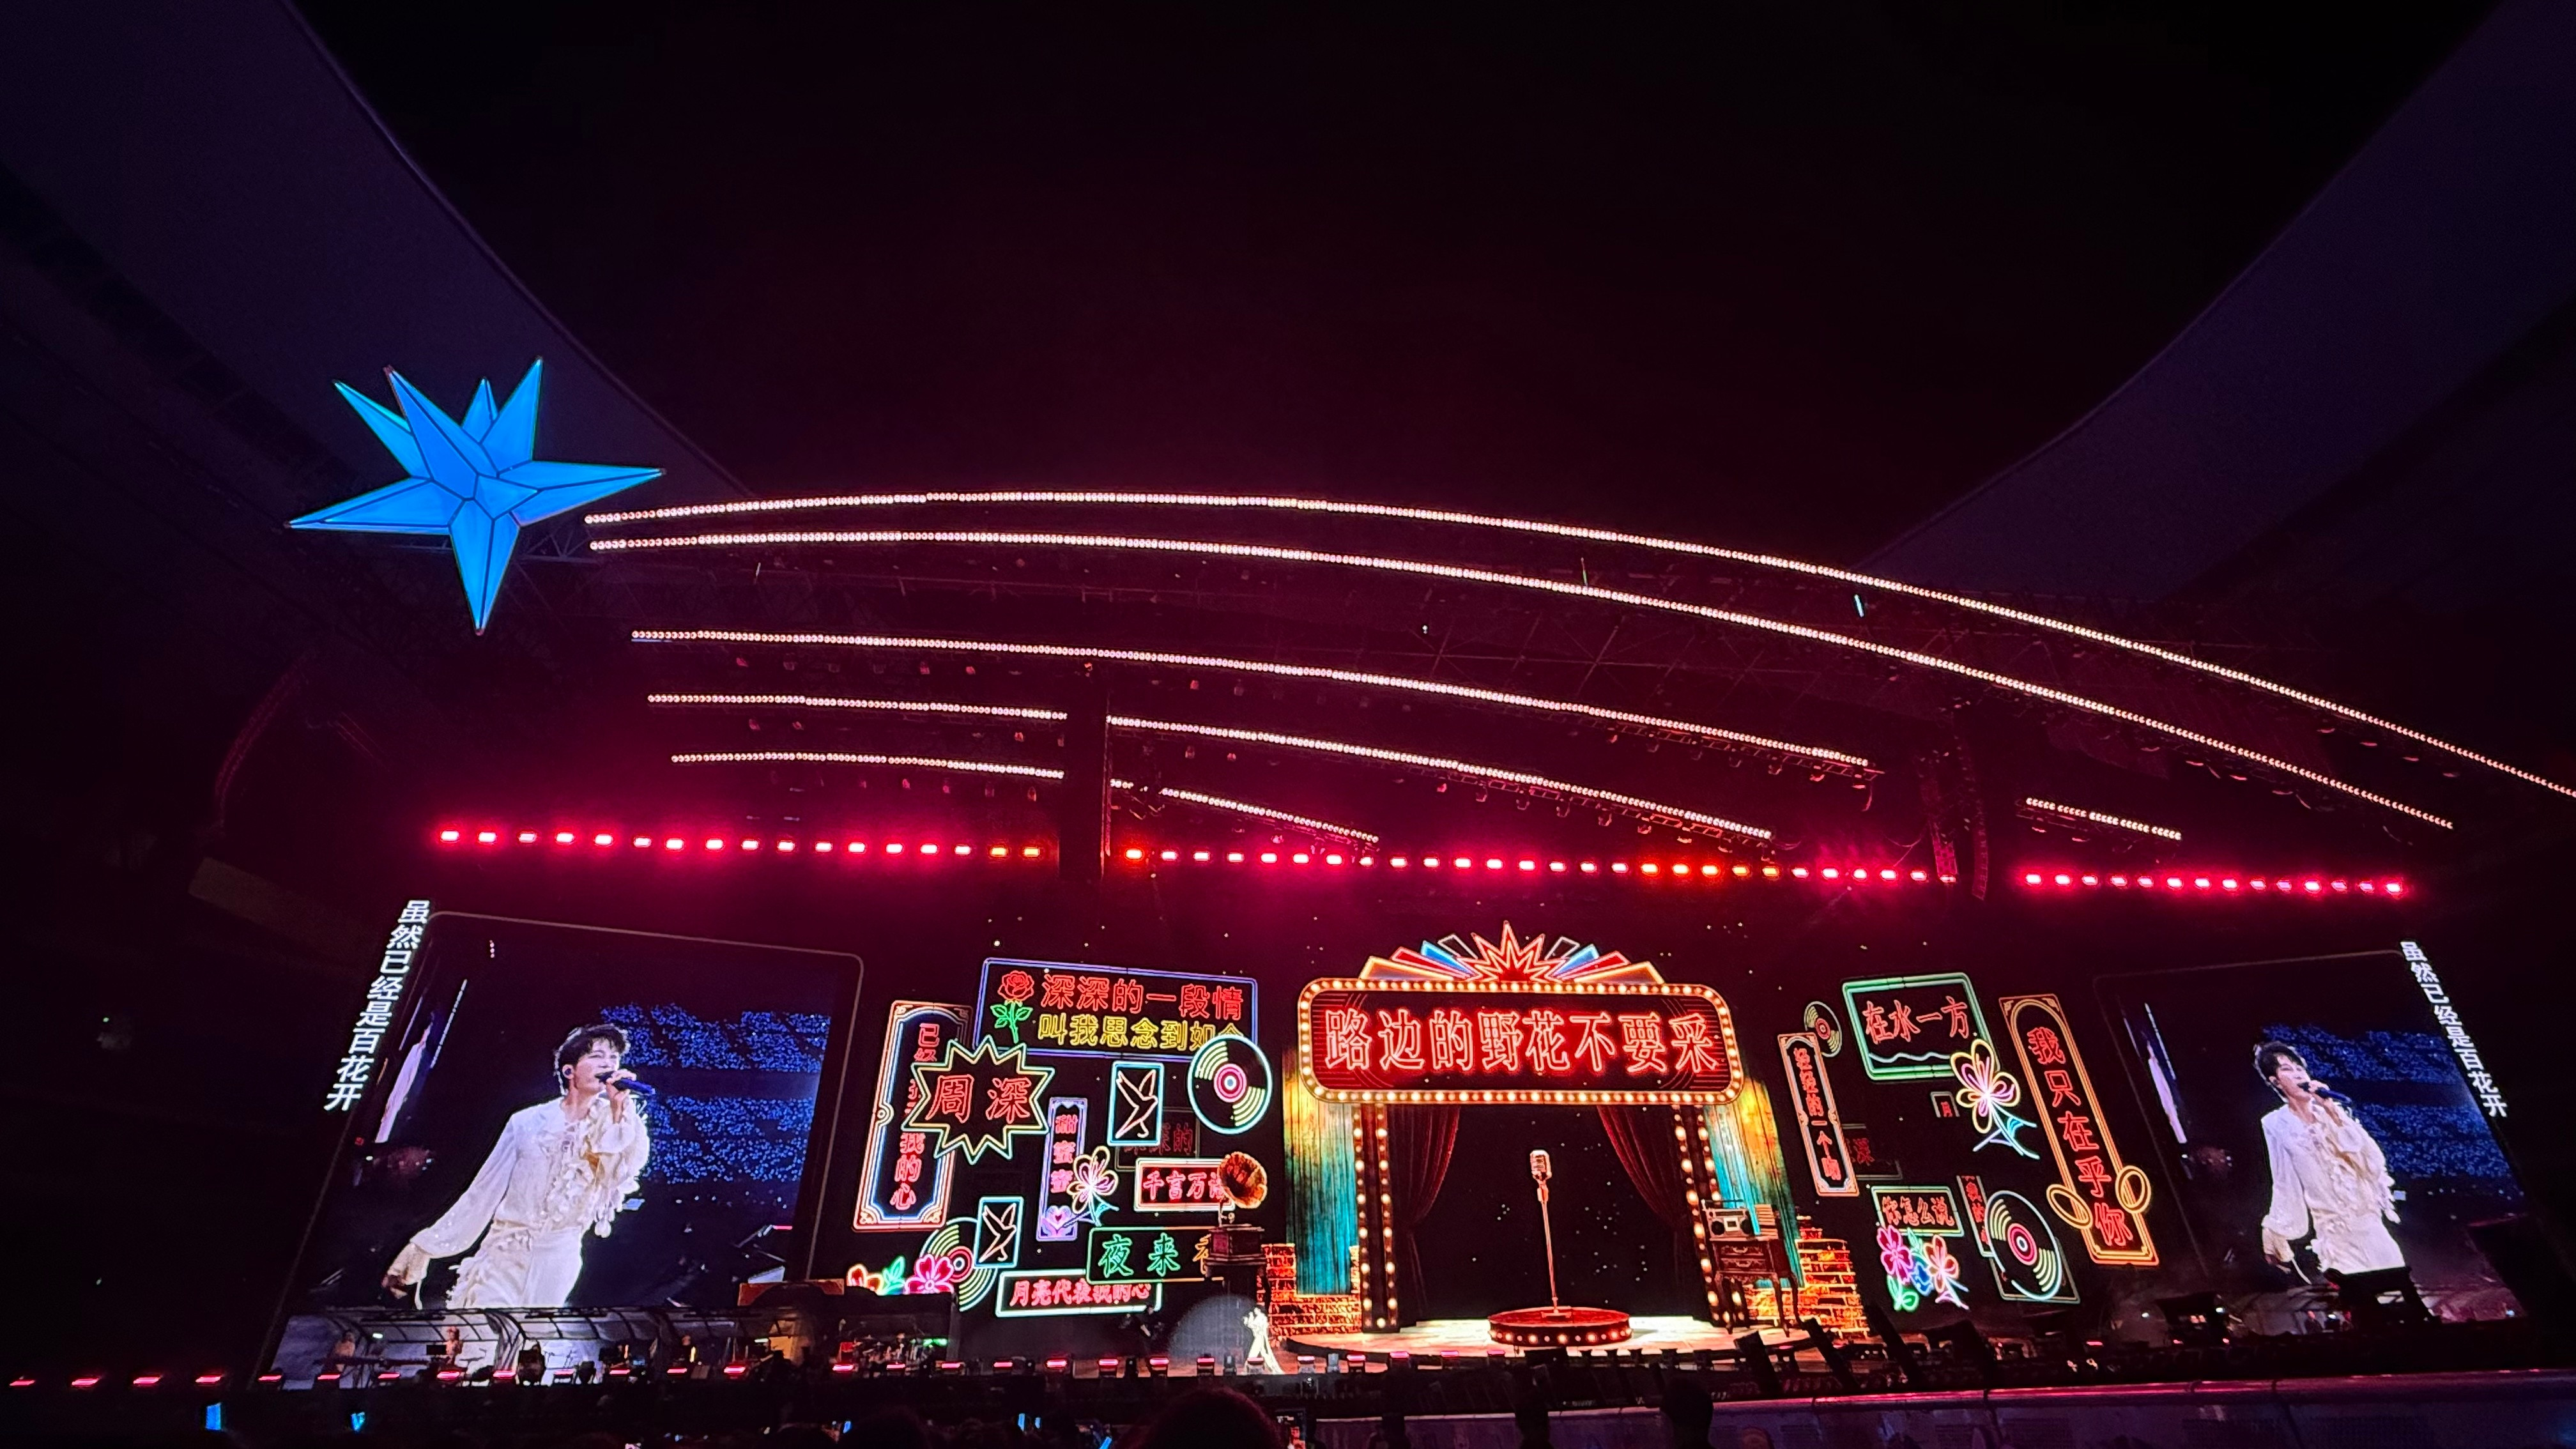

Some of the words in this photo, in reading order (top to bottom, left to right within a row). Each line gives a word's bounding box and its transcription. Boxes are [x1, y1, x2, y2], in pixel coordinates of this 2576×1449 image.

[324, 900, 430, 1111] 虽然已经是百花开
[1041, 974, 1244, 1020] 深深的一段情
[1862, 995, 1970, 1045] 在水一方
[2400, 941, 2508, 1117] 虽然已经是百花开
[1324, 1009, 1719, 1073] 路边的野花不要采
[925, 1074, 1031, 1124] 周深
[1793, 1047, 1842, 1181] 轻轻的一个吻
[1050, 1114, 1078, 1193] 甜蜜蜜
[2027, 1026, 2134, 1246] 我只在乎你
[1882, 1195, 1955, 1226] 你怎么说
[1009, 1278, 1152, 1307] 月亮代表我的心
